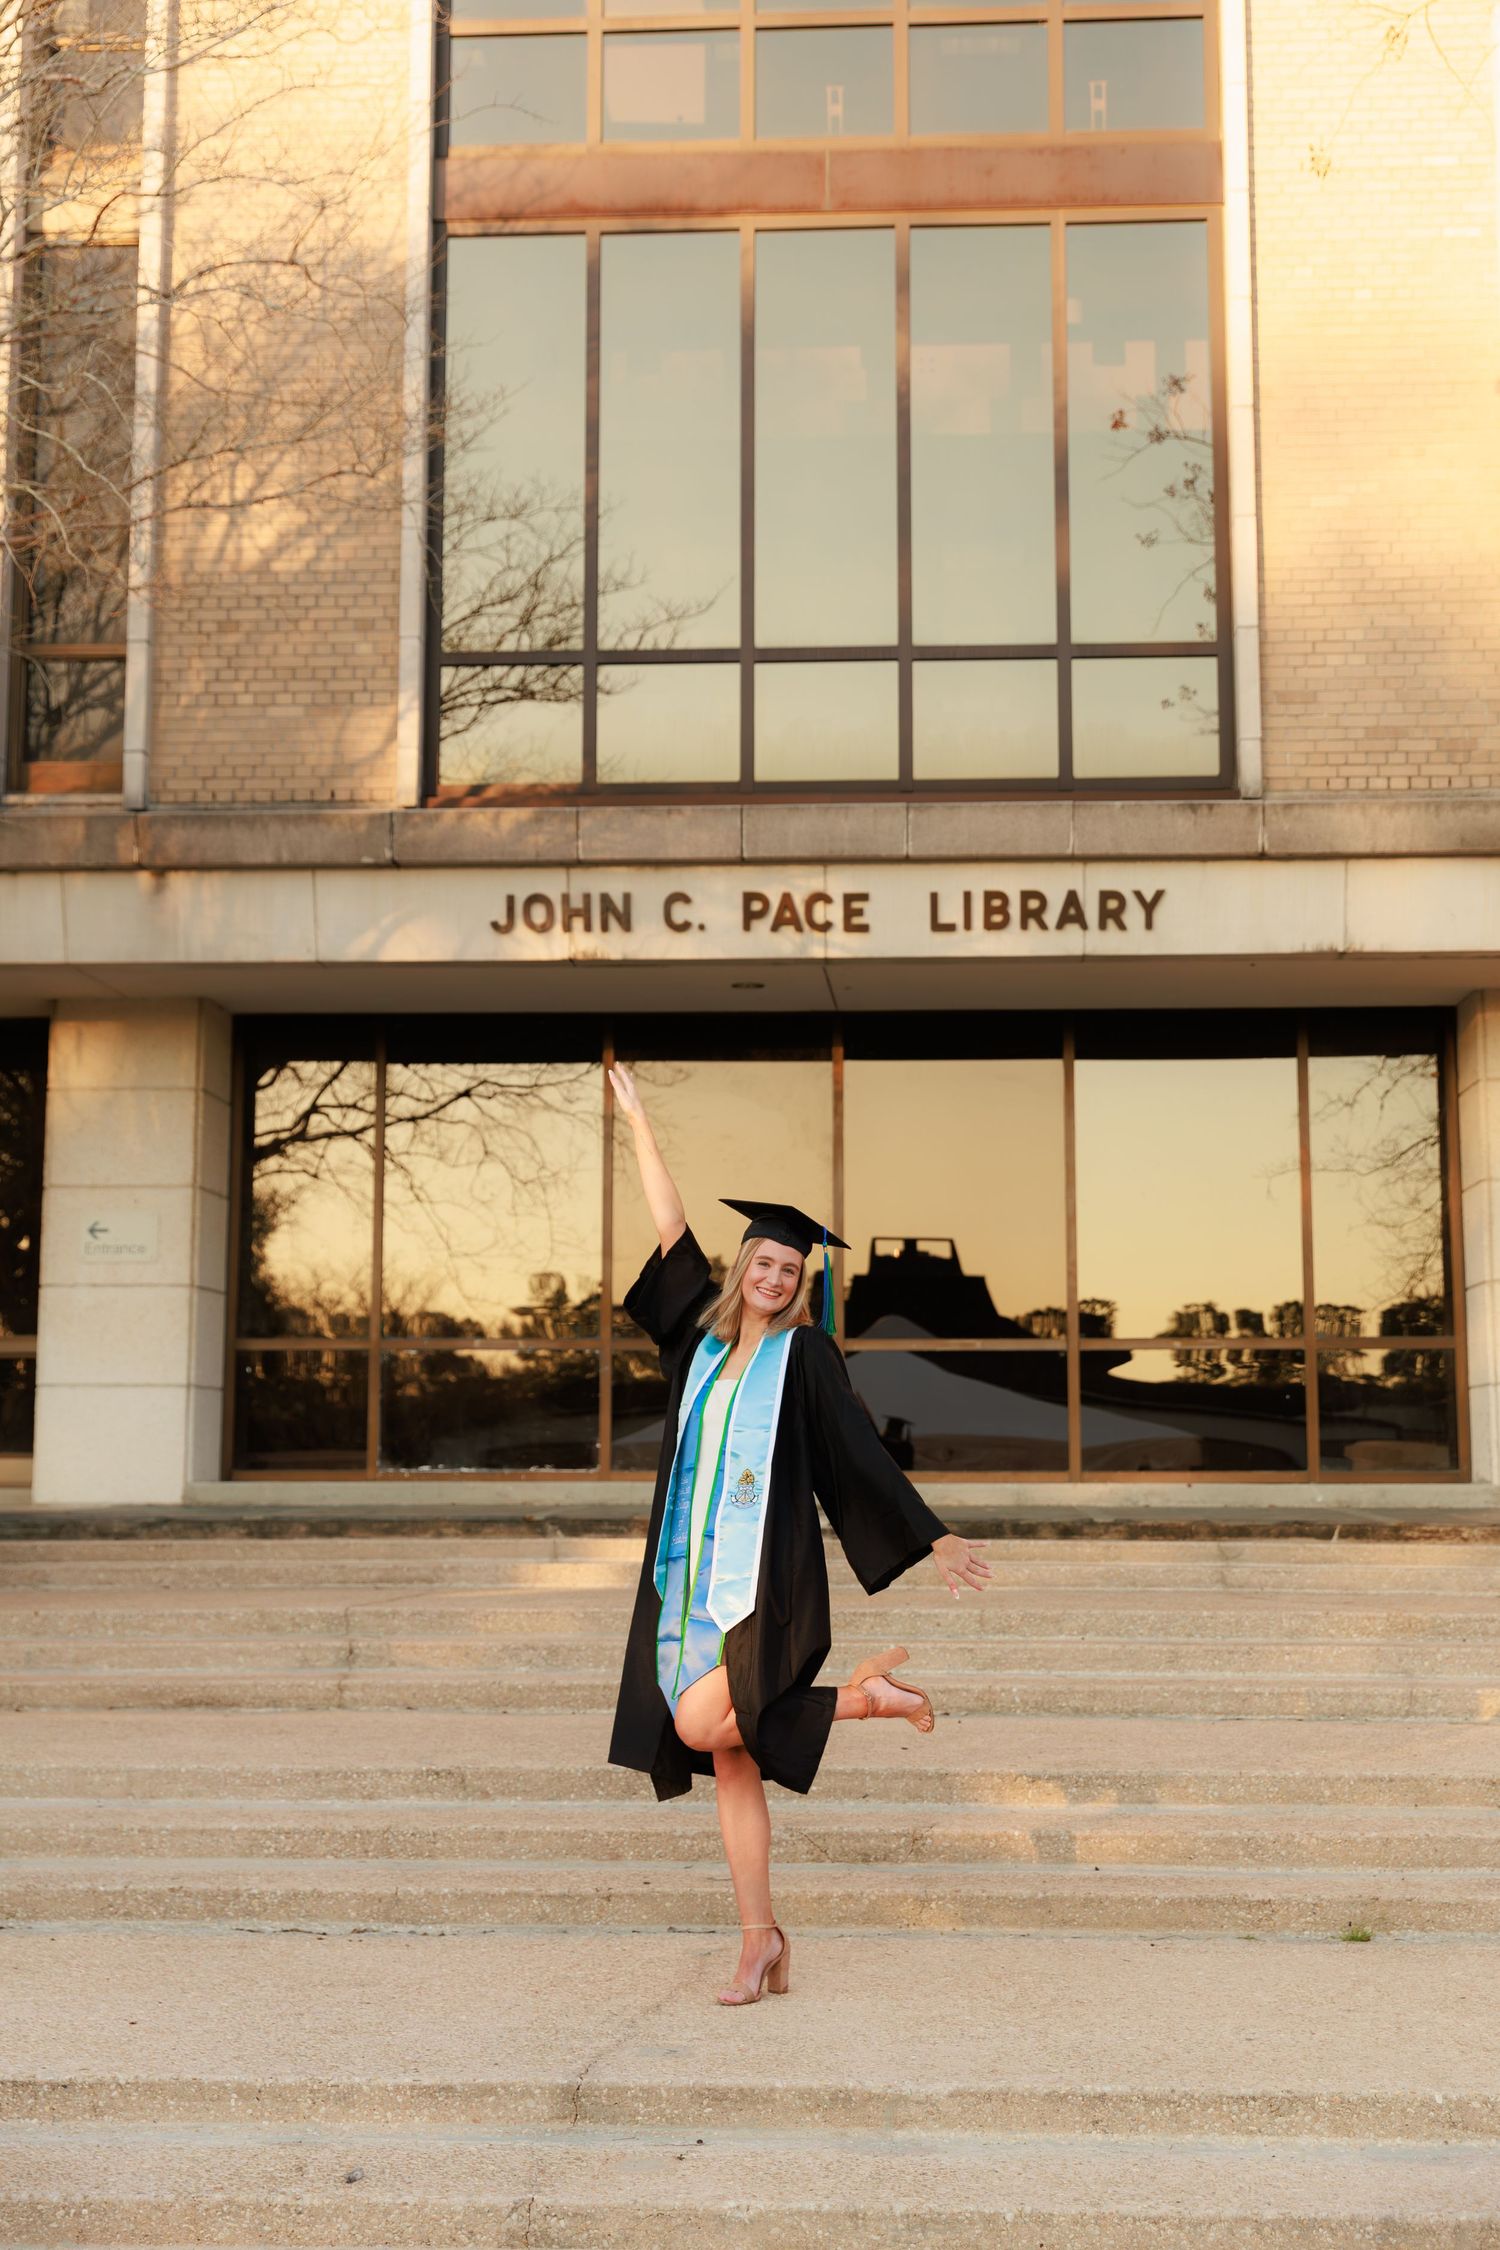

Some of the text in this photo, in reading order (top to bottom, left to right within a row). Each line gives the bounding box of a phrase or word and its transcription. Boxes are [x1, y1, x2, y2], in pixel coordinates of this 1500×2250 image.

[490, 889, 1166, 934] JOHN C. PACE LIBRARY
[83, 1241, 146, 1255] Entrance
